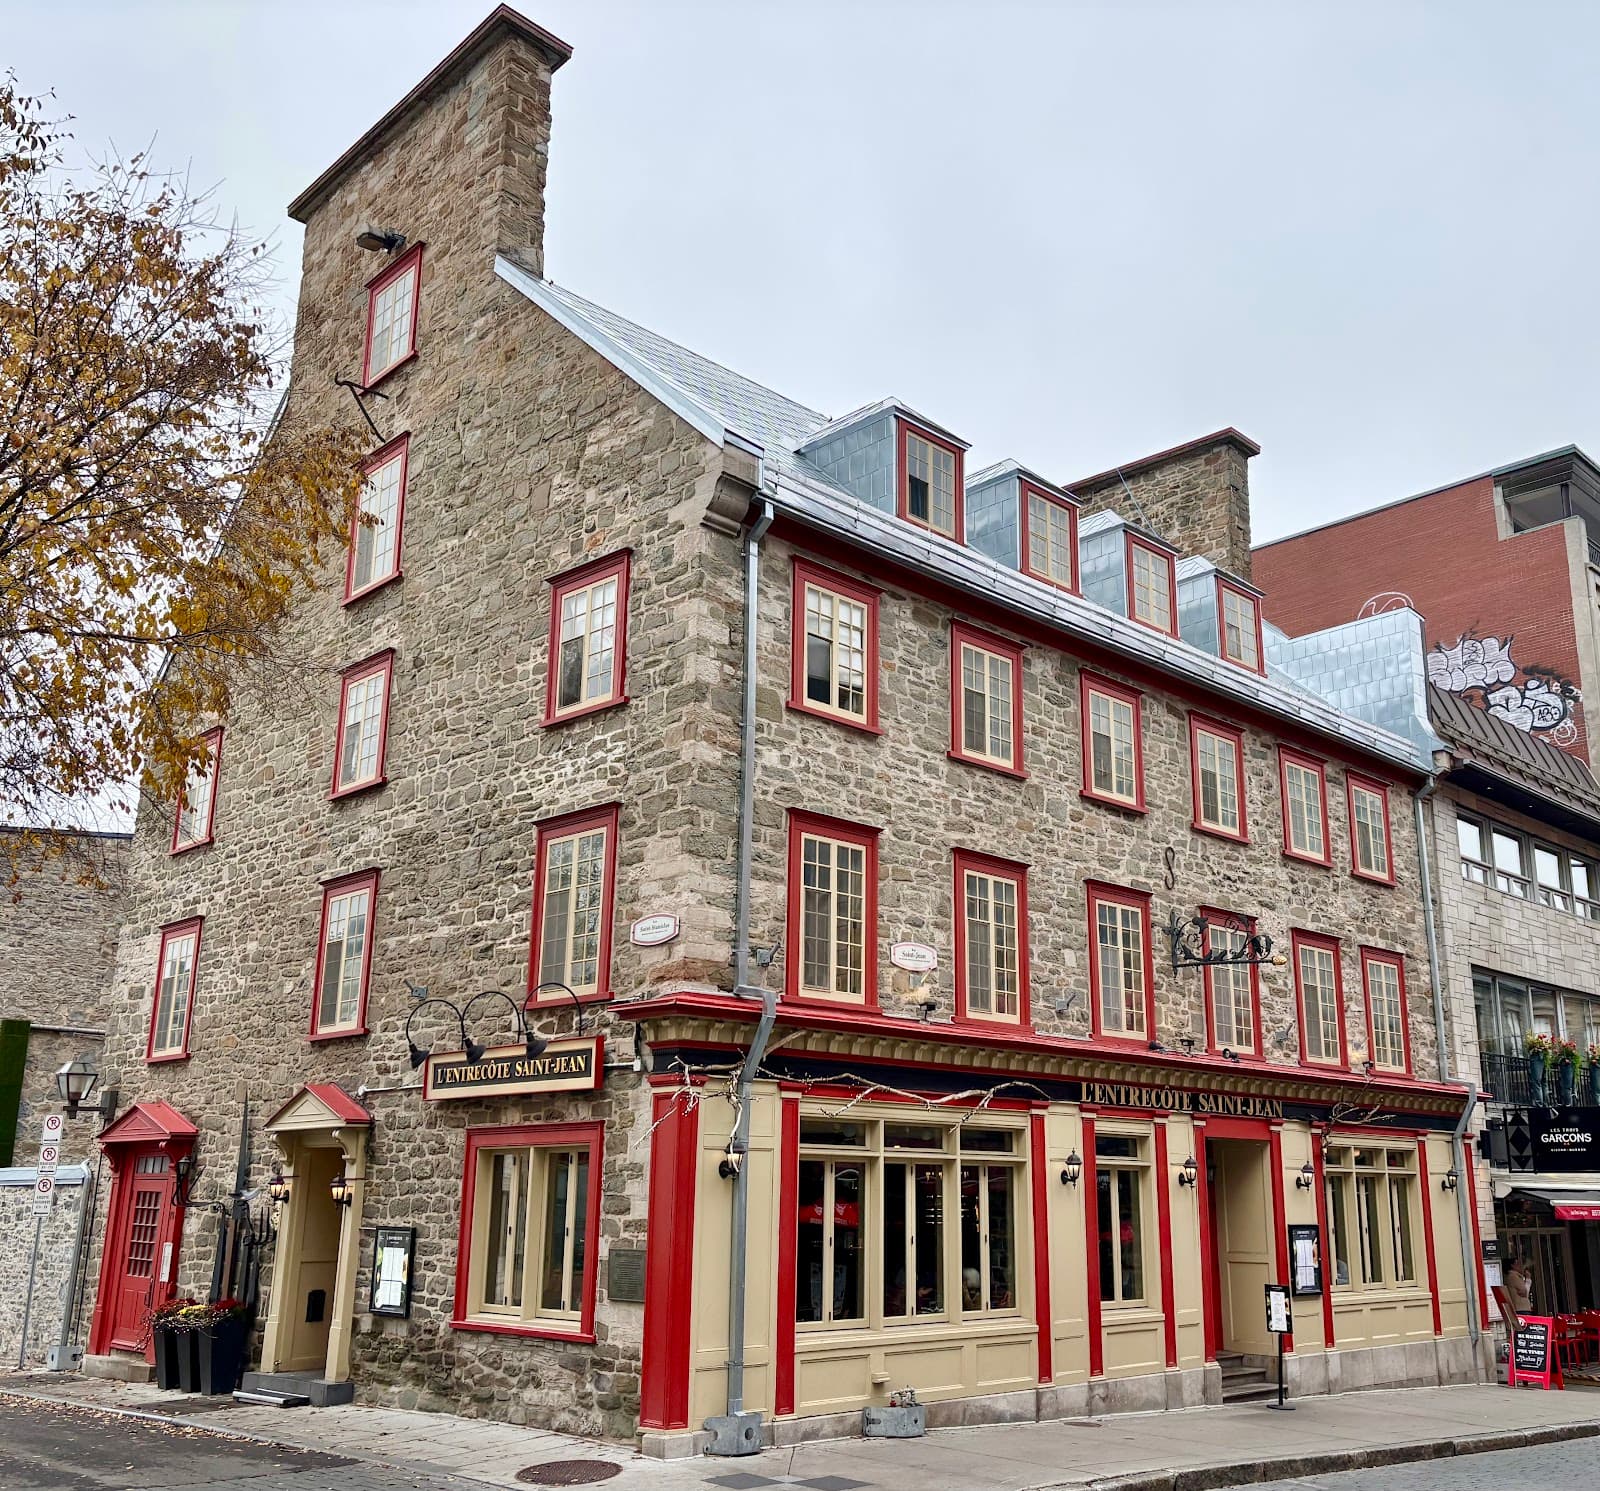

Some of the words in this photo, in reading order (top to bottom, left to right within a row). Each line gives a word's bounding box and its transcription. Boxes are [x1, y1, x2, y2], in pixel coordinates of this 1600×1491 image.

[437, 1060, 511, 1084] L'ENTRECÔTE
[514, 1054, 588, 1077] SAINT-JEAN
[1081, 1081, 1193, 1111] L'ENTRECÔTE
[1199, 1093, 1283, 1118] SAINT-JEAN
